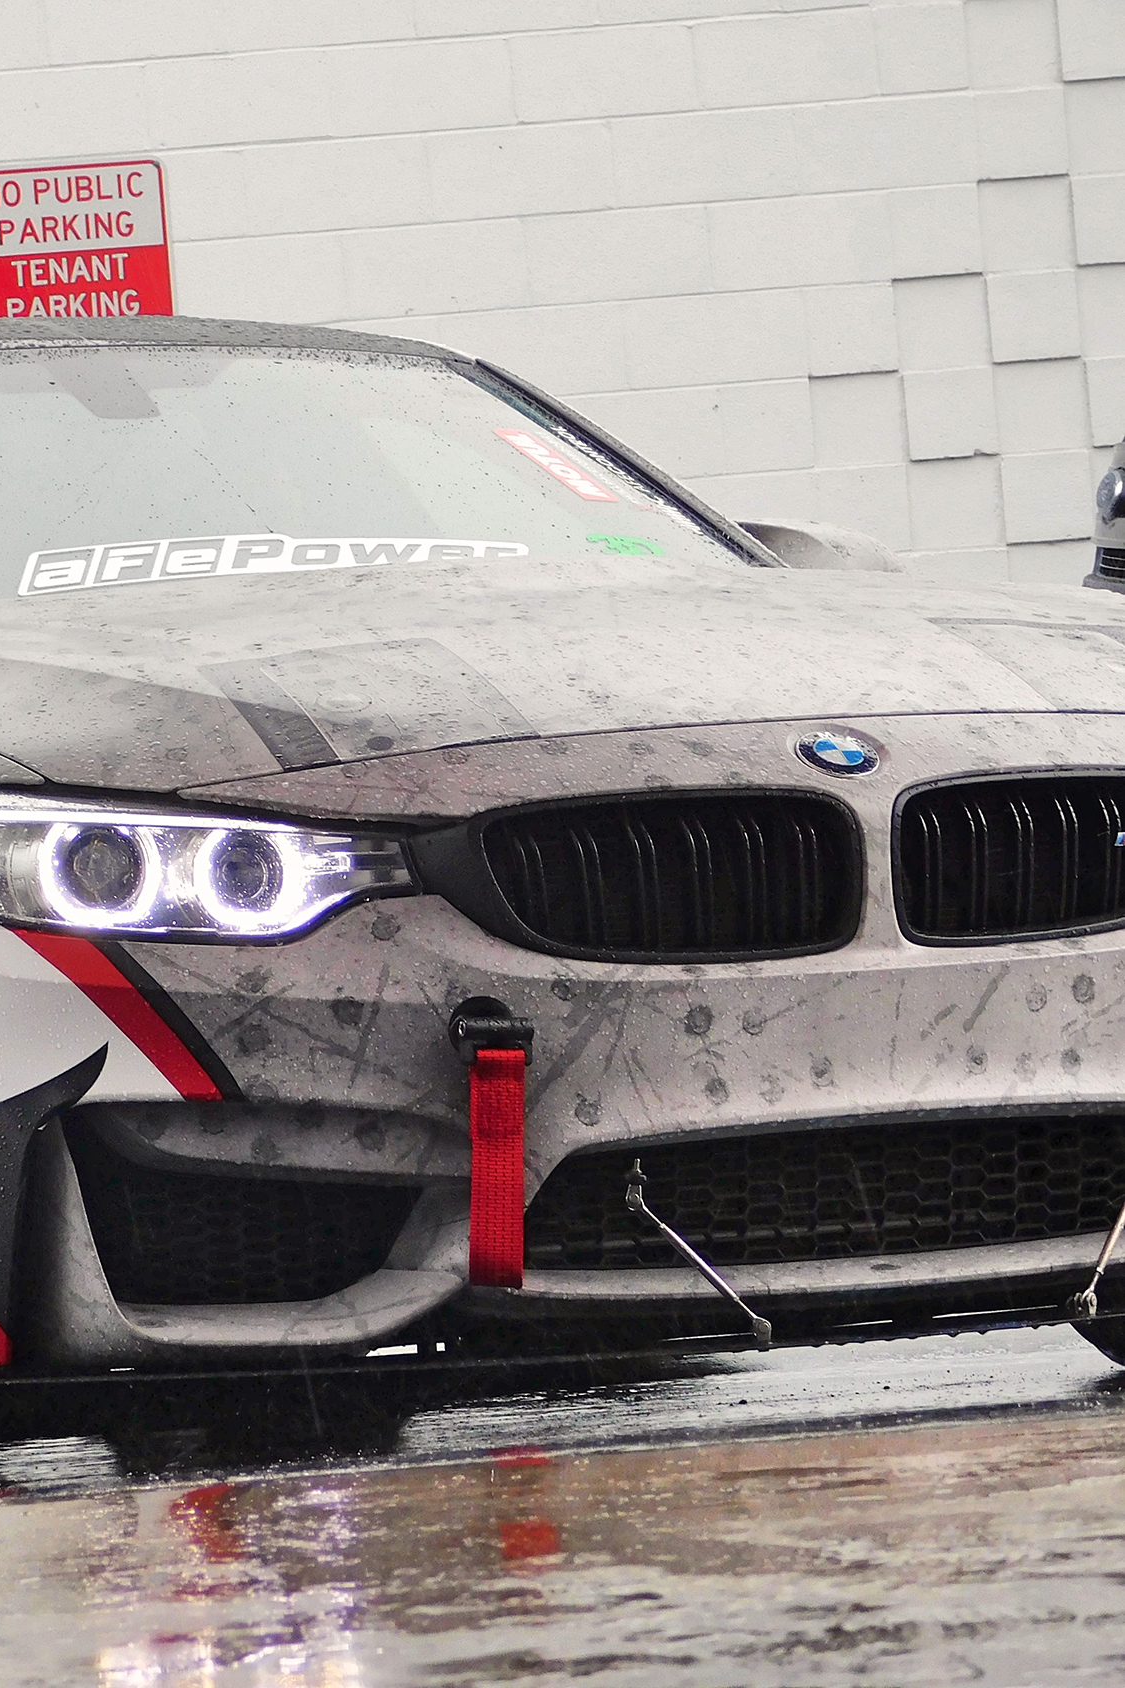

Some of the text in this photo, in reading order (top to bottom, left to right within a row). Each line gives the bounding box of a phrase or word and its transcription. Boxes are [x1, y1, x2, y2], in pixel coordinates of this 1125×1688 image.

[33, 171, 145, 205] PUBLIC
[10, 252, 129, 288] TENANT
[5, 288, 141, 318] PARKING
[503, 433, 612, 500] MOTUL
